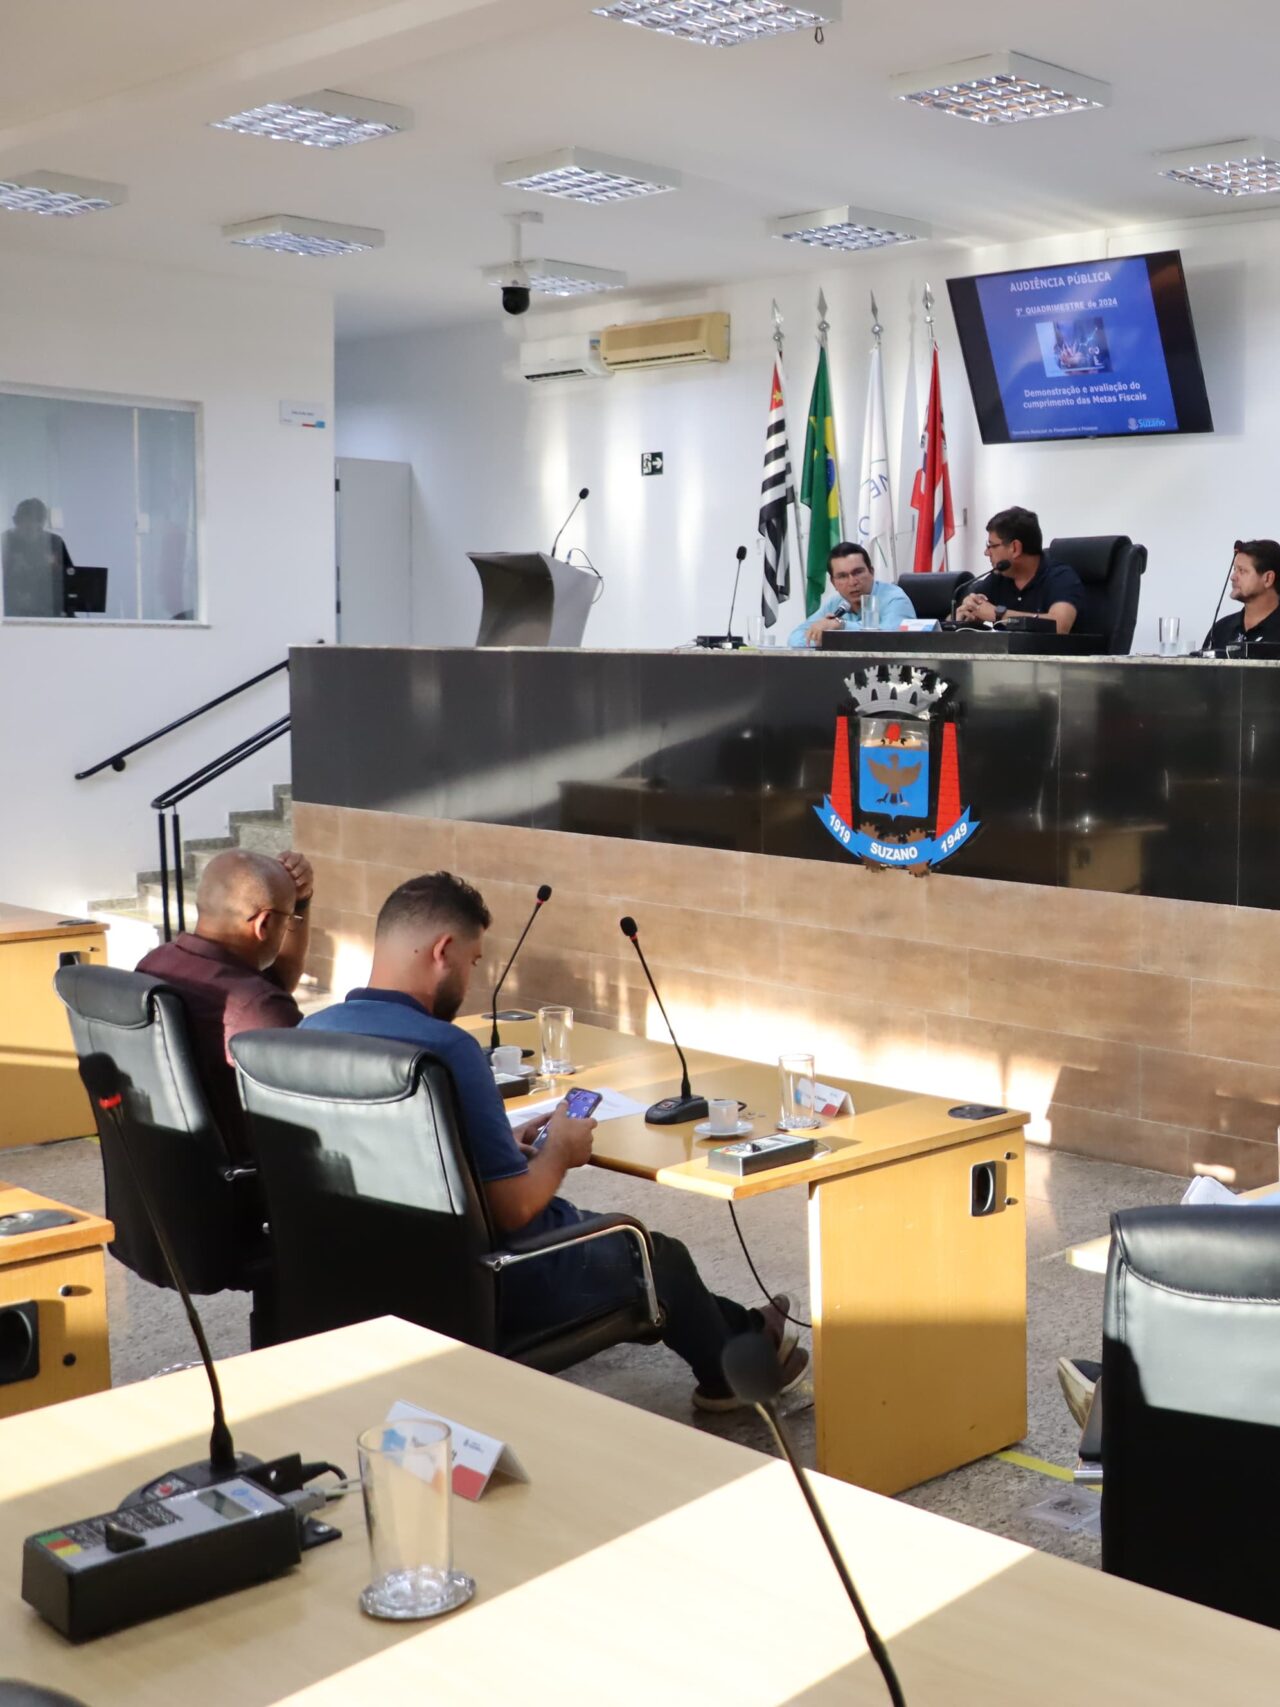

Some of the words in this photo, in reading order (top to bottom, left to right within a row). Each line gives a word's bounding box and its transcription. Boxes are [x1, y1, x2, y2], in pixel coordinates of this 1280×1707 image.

[1010, 276, 1065, 292] AUDIÊNCIA
[1067, 271, 1112, 286] PÚBLICA
[1026, 301, 1084, 314] QUADRIMESTRE
[1087, 300, 1097, 308] de
[1098, 297, 1118, 306] 2024
[1024, 385, 1080, 397] Demonstração
[1090, 382, 1128, 393] avaliação
[1130, 381, 1141, 390] do
[1023, 397, 1075, 408] cumprimento
[1077, 397, 1091, 405] das
[1093, 394, 1117, 404] Metas
[1119, 392, 1147, 402] Fiscais
[829, 814, 851, 844] 1919
[940, 822, 968, 853] 1949
[870, 842, 918, 860] SUZANO
